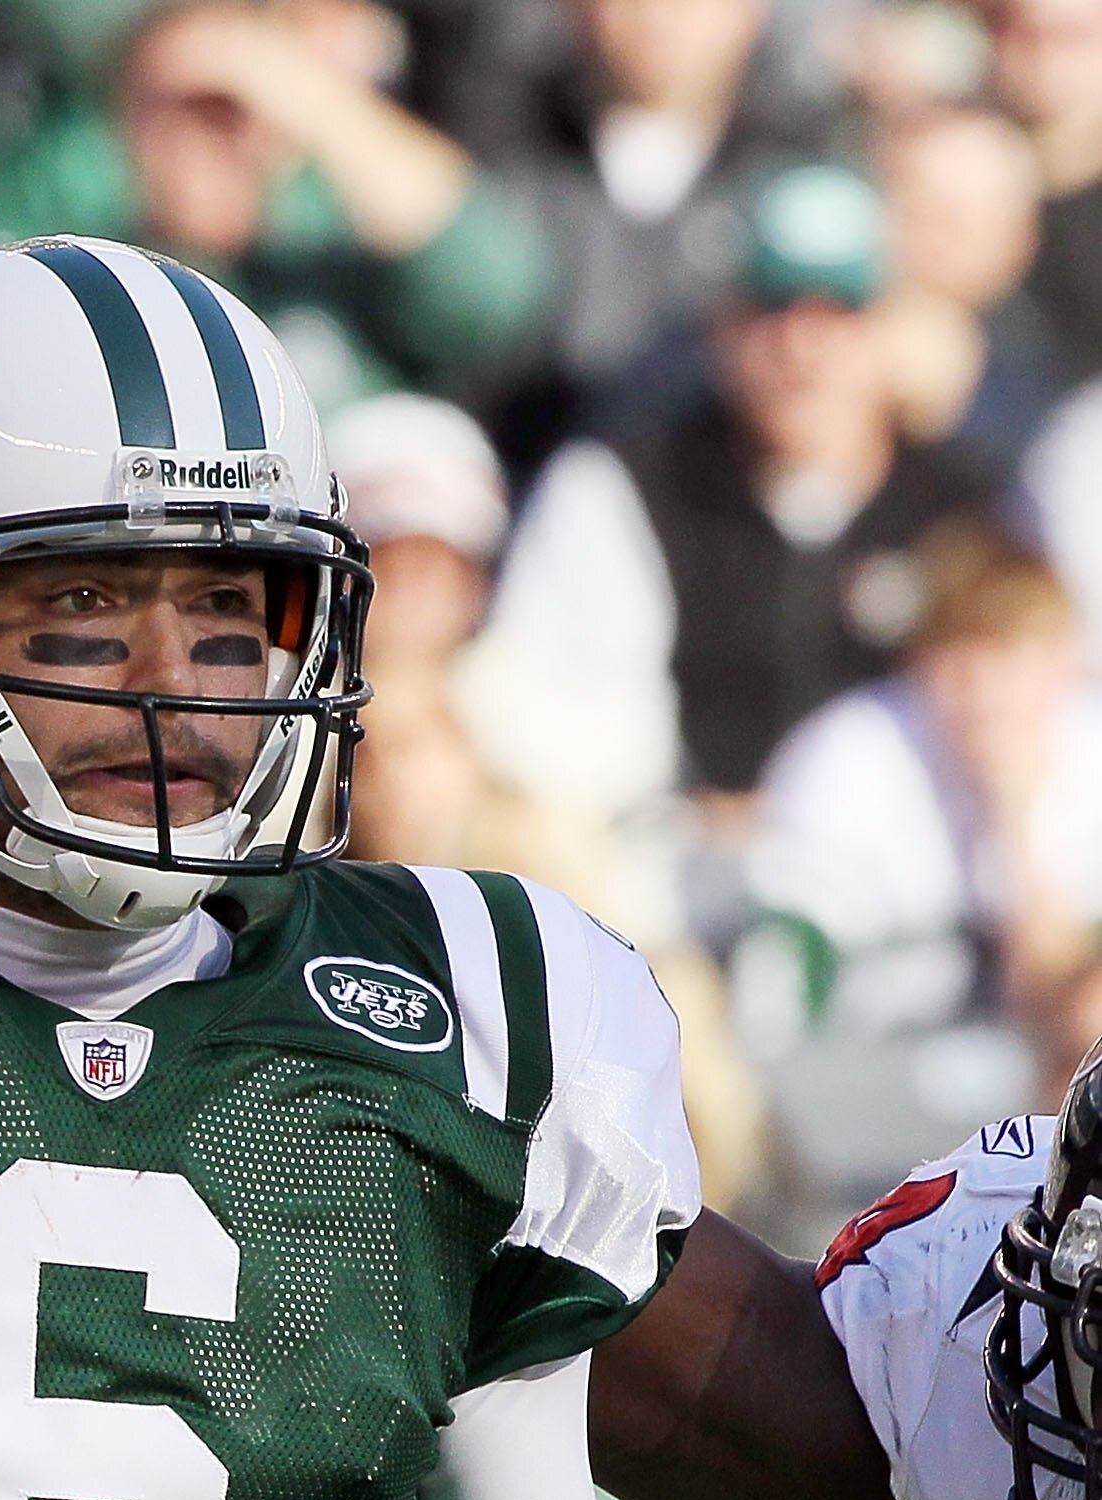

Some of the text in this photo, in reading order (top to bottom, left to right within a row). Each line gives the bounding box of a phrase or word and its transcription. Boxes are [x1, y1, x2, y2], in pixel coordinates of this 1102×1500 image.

[159, 457, 251, 489] Riddell
[329, 980, 429, 1019] JETS
[88, 1059, 122, 1083] NFL
